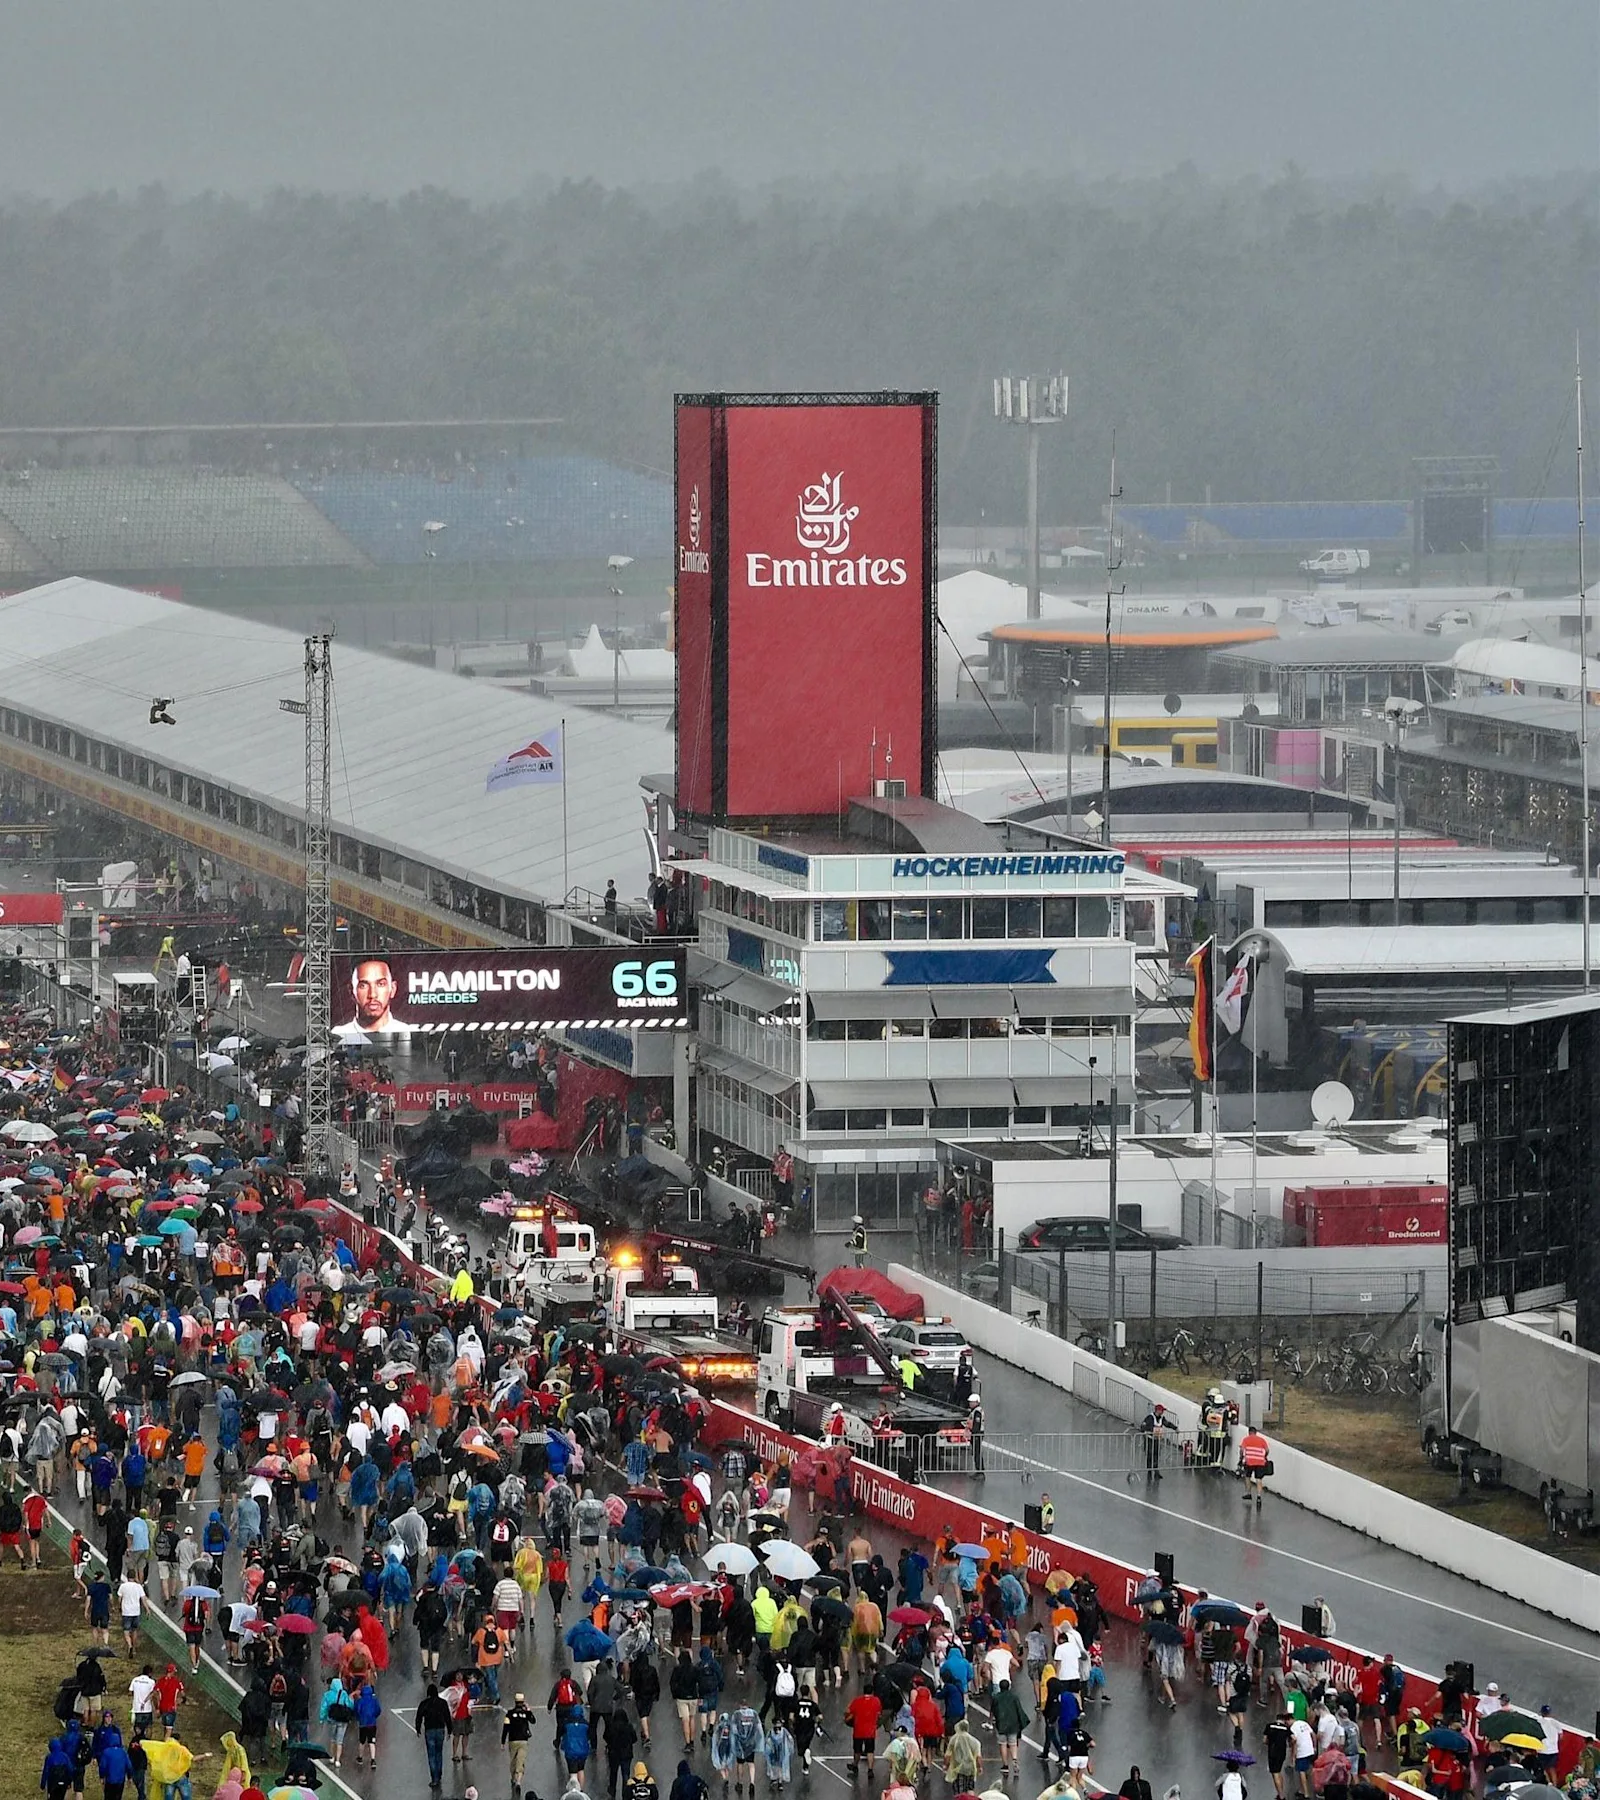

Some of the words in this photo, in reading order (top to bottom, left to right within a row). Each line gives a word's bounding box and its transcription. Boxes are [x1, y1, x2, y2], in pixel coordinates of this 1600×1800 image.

[680, 545, 709, 573] Emirates
[746, 552, 907, 587] Emirates
[1127, 605, 1169, 614] DINAMIC
[892, 855, 1125, 877] HOCKENHEIMRING
[408, 968, 560, 992] HAMILTON
[612, 961, 677, 997] 66
[408, 992, 478, 1004] MERCEDES
[617, 997, 646, 1007] RACE
[647, 996, 678, 1007] WINS
[407, 1091, 424, 1103] Fly
[484, 1091, 500, 1103] Fly
[1388, 1230, 1440, 1238] Bredenoord
[853, 1471, 870, 1508] Fly
[872, 1479, 916, 1521] Emirates
